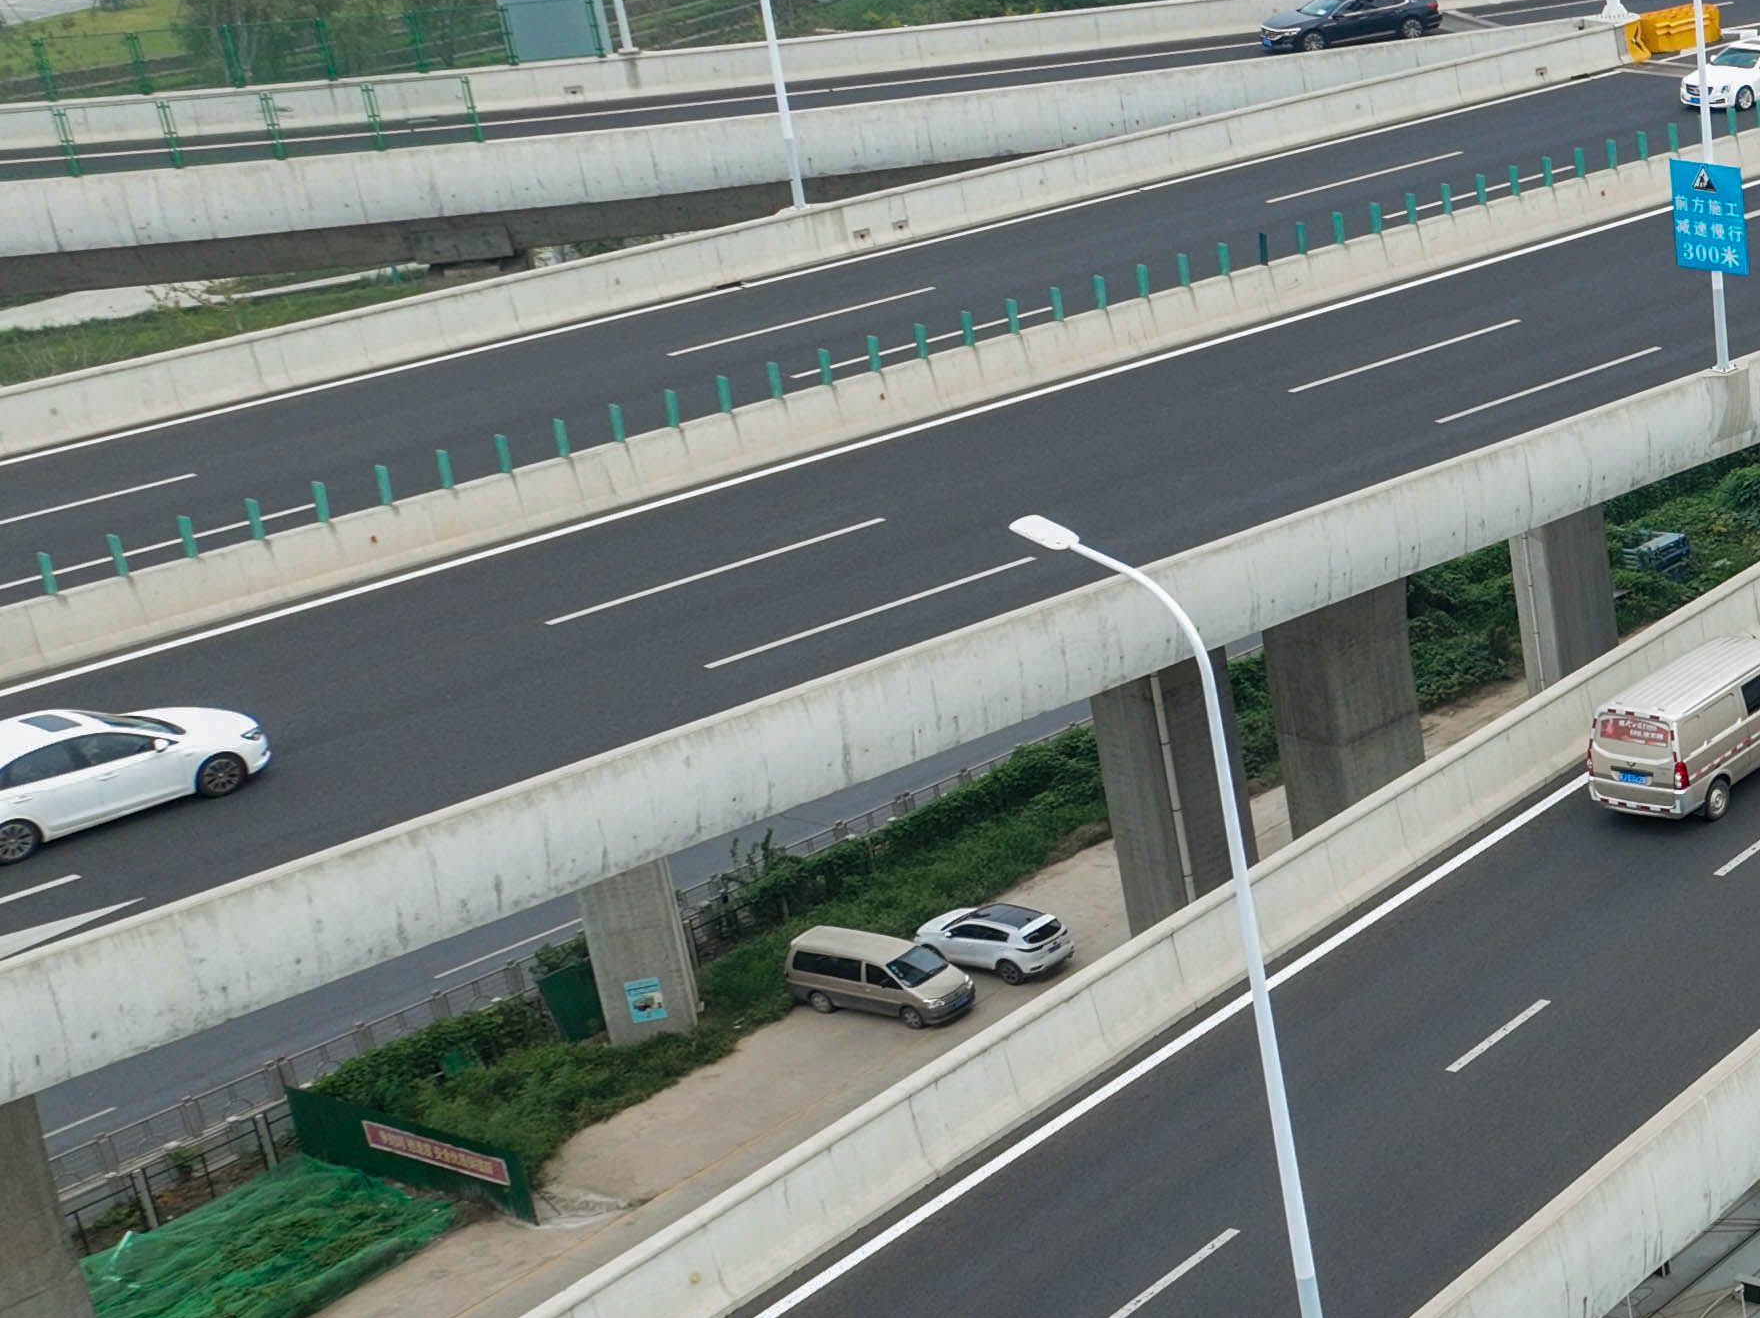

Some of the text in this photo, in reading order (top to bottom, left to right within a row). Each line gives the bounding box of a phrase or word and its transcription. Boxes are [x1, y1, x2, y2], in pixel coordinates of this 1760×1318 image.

[1674, 195, 1740, 218] 前方施工
[1675, 218, 1743, 243] 减速慢行
[1683, 242, 1740, 268] 300米
